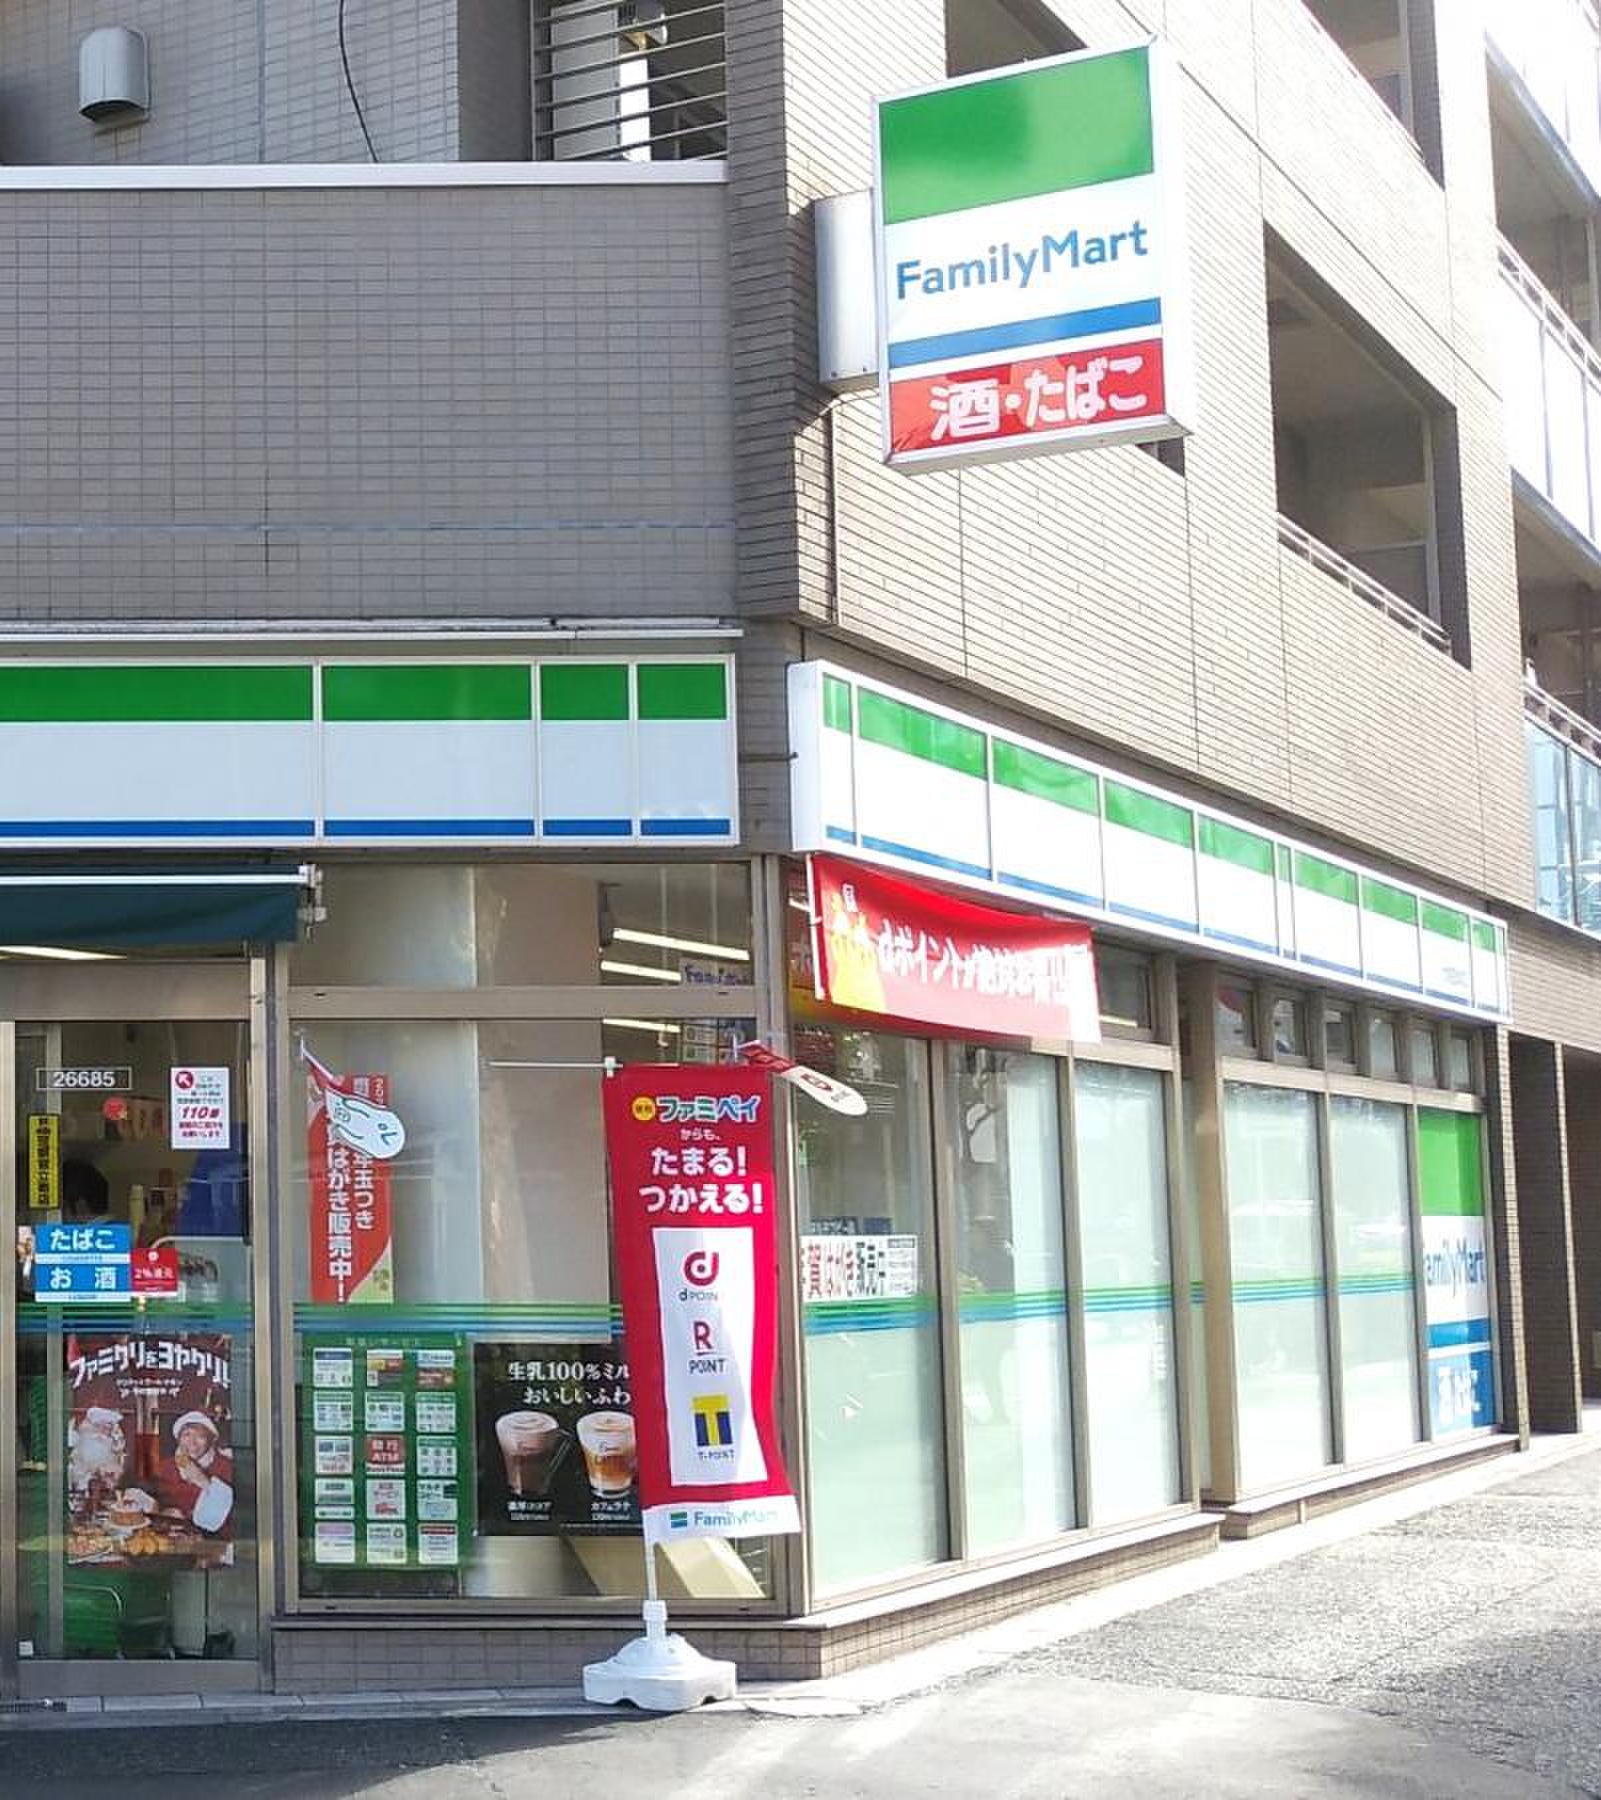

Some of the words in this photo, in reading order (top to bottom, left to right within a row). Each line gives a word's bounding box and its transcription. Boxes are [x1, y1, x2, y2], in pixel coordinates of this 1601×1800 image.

[896, 220, 1148, 300] FamilyMart
[929, 355, 1148, 441] 酒・たばこ
[53, 1071, 116, 1088] 26685
[657, 1095, 761, 1123] ファミペイ
[651, 1146, 747, 1177] たまる!
[638, 1183, 765, 1214] つかえる!
[50, 1228, 116, 1251] たばこ
[688, 1358, 728, 1375] POINT
